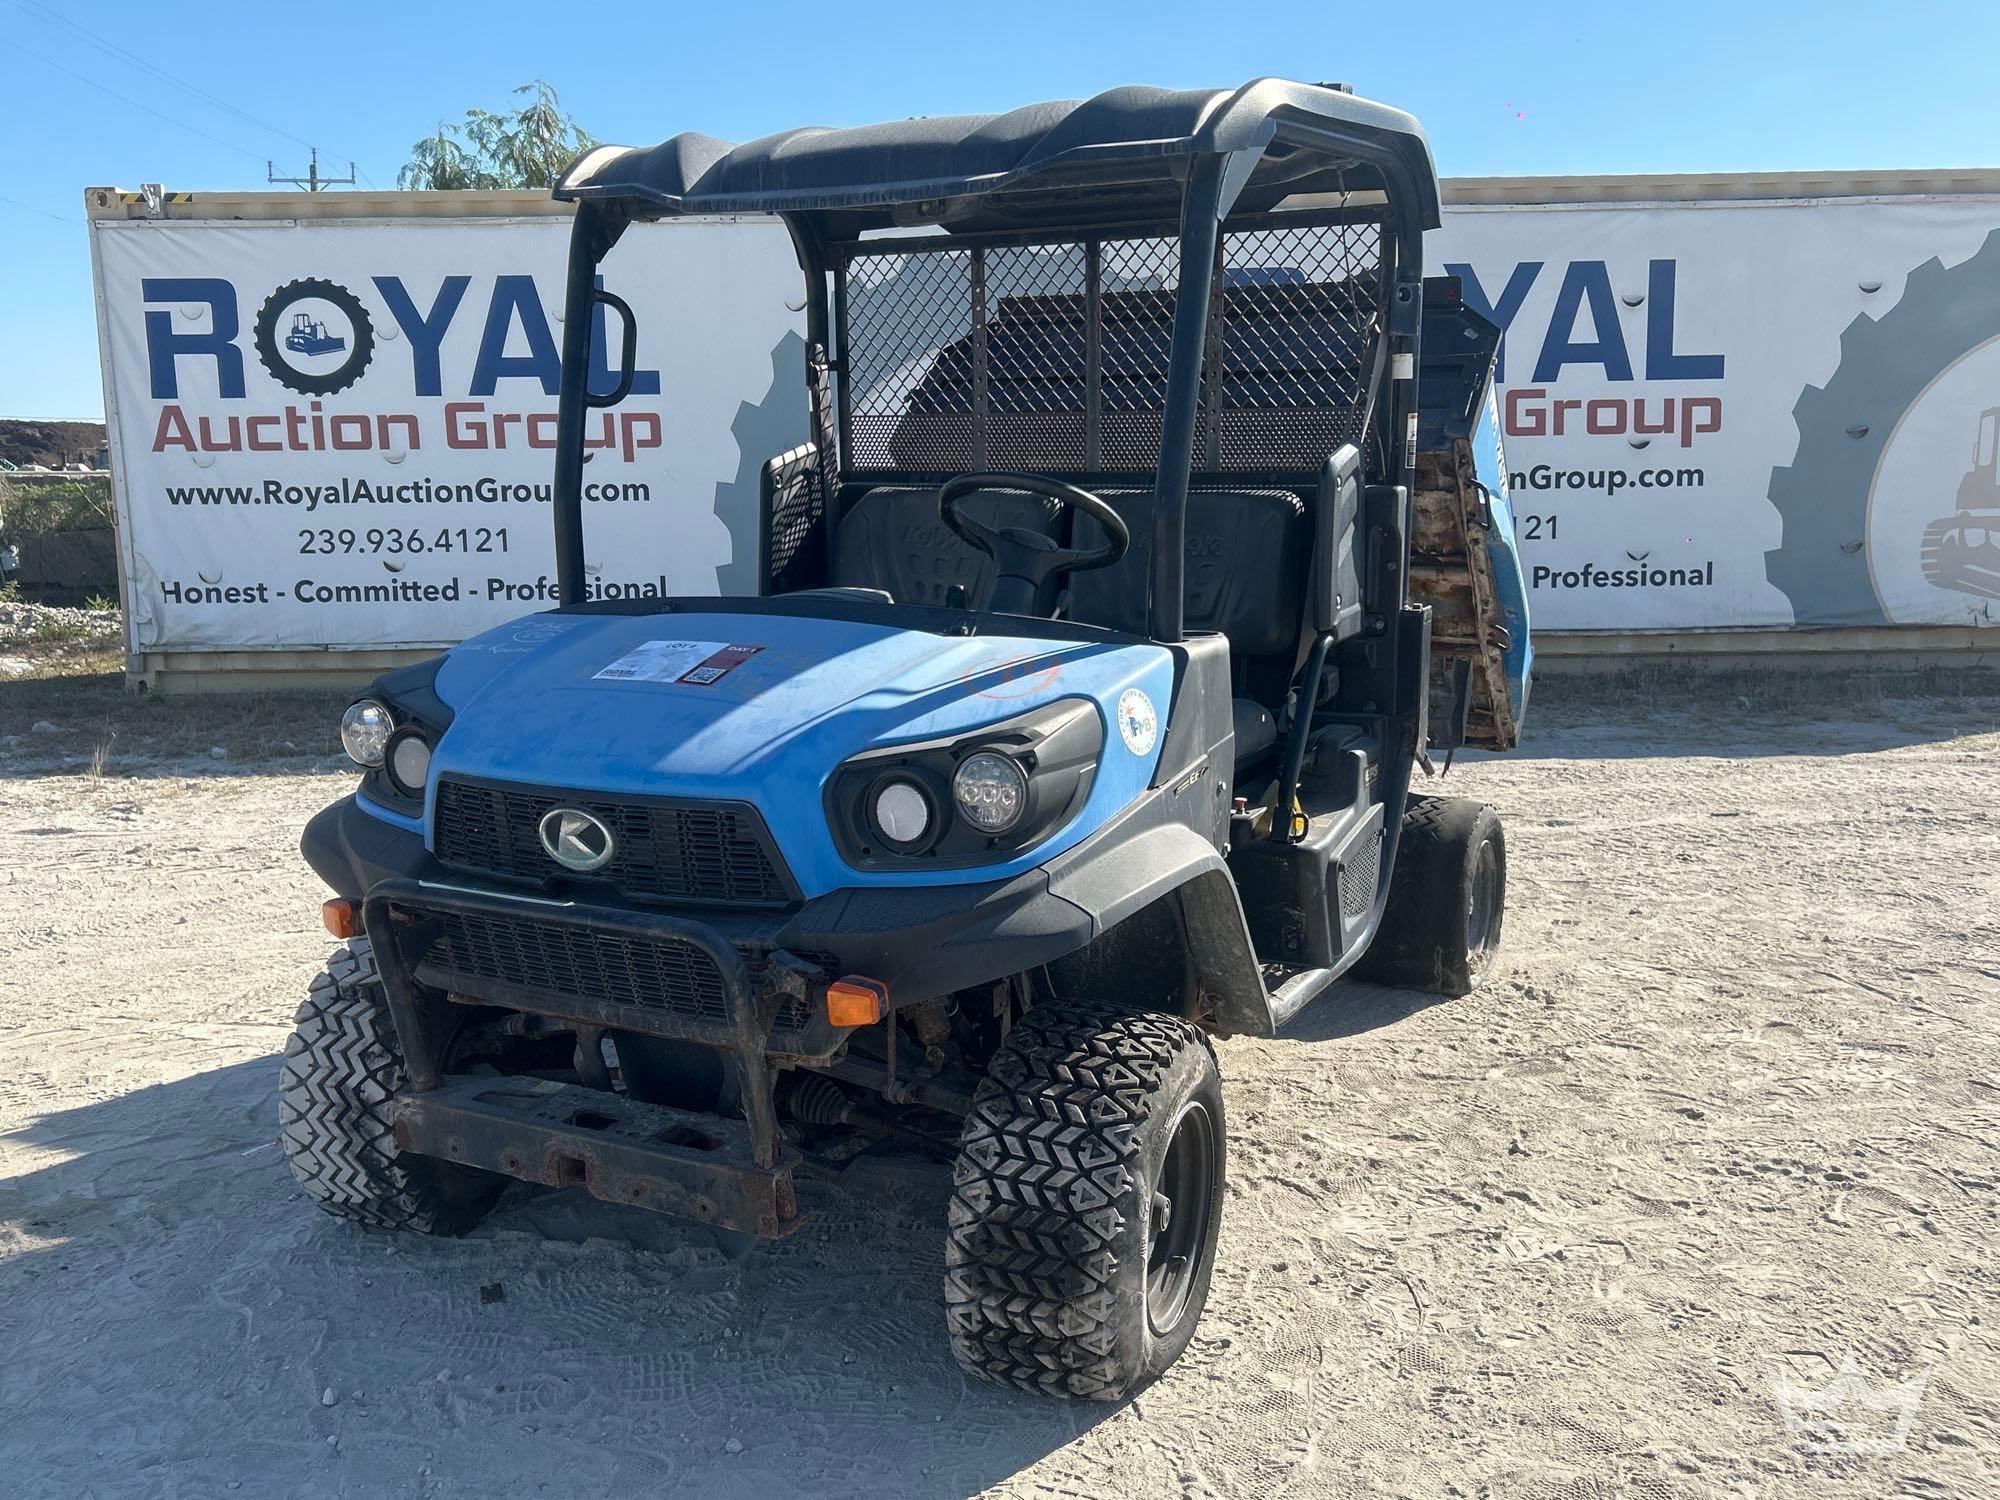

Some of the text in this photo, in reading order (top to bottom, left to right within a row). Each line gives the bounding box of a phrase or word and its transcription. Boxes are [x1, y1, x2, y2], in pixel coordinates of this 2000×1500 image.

[141, 274, 661, 398] ROYAL
[1443, 259, 1725, 383] YAL
[151, 401, 662, 462] Auction Group
[1505, 388, 1722, 448] Group
[165, 477, 650, 511] www.RoyalAuctionGroucom
[1509, 464, 1704, 495] nGroup.com
[298, 527, 508, 554] 239.936.4121
[161, 581, 269, 604] Honest
[294, 577, 459, 604] Committed
[487, 575, 667, 601] Profesional
[1533, 562, 1713, 588] Professional
